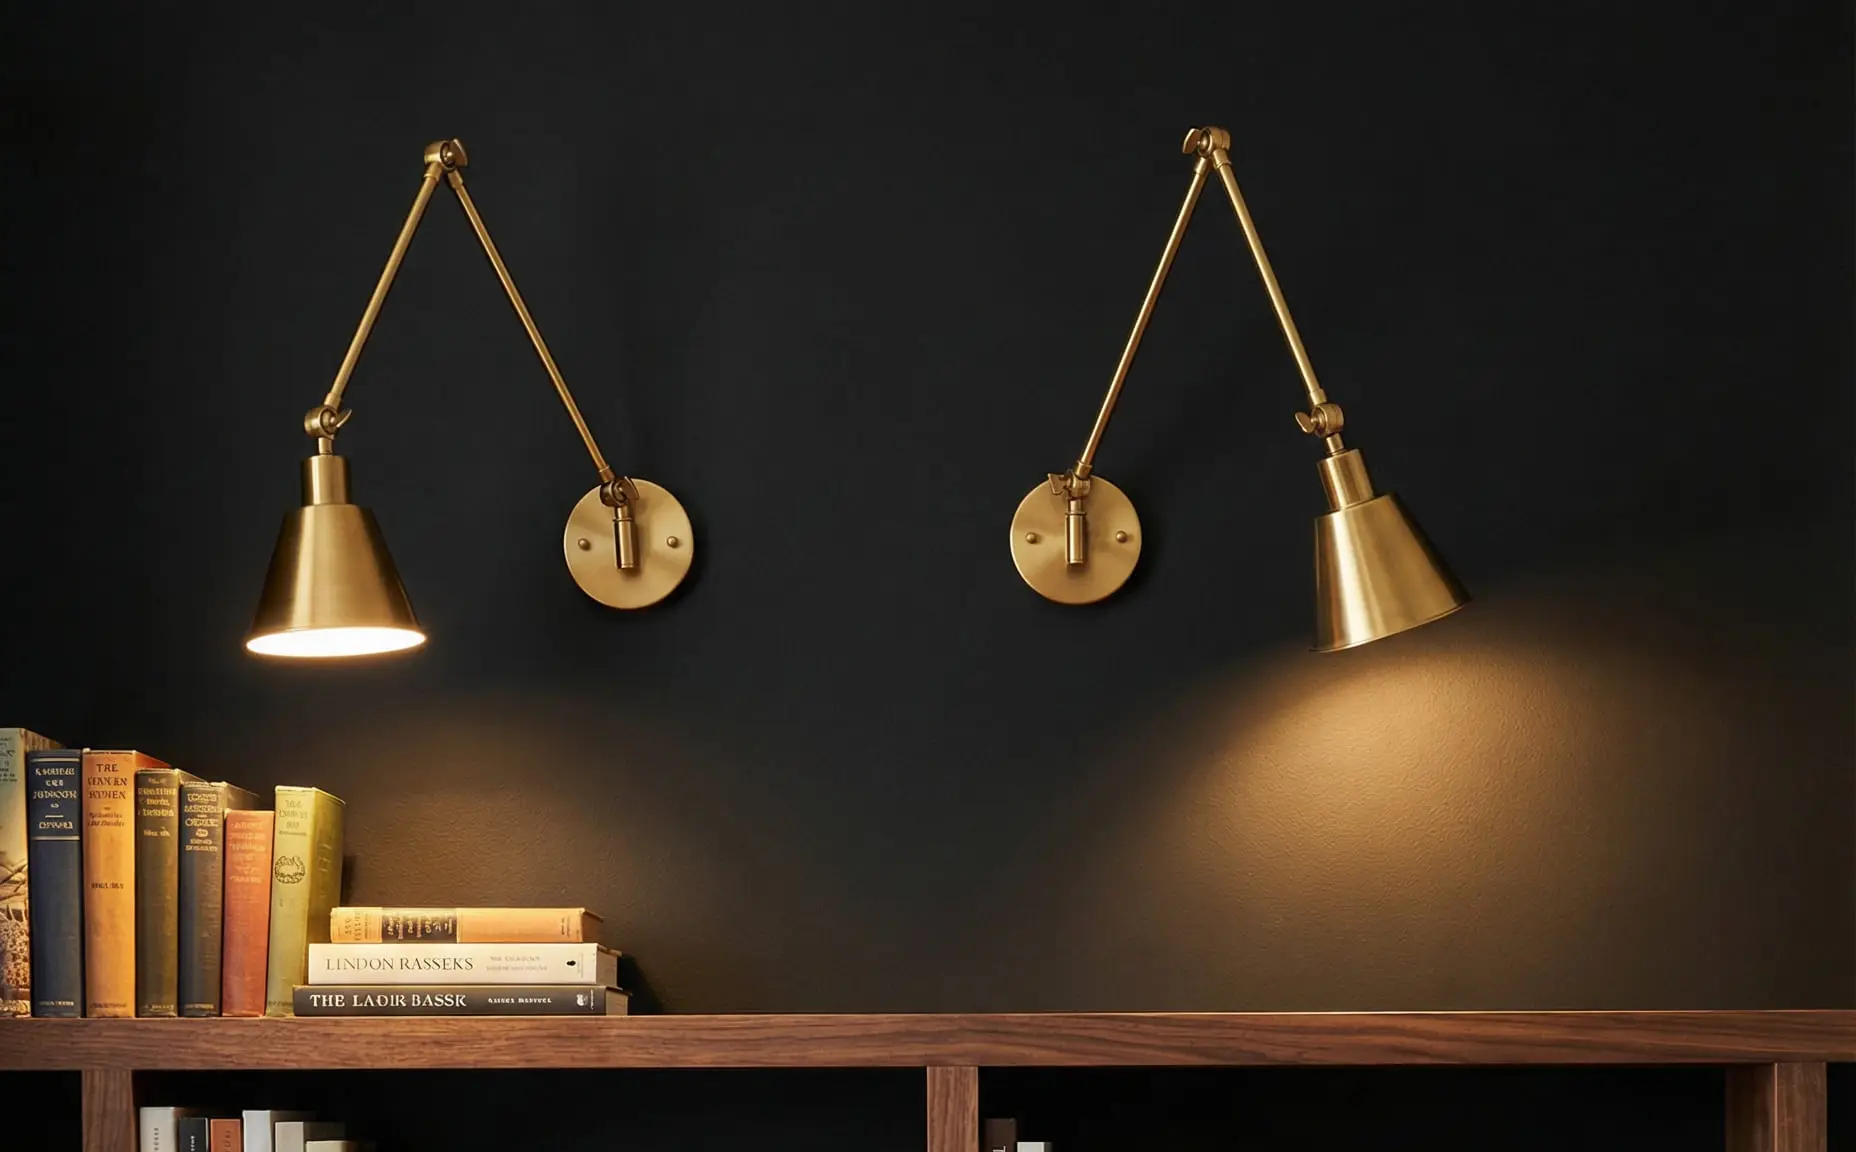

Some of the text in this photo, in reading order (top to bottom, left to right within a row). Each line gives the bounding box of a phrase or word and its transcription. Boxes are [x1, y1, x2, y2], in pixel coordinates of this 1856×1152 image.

[326, 957, 474, 971] LINDON RASSEKS
[309, 994, 345, 1007] THE
